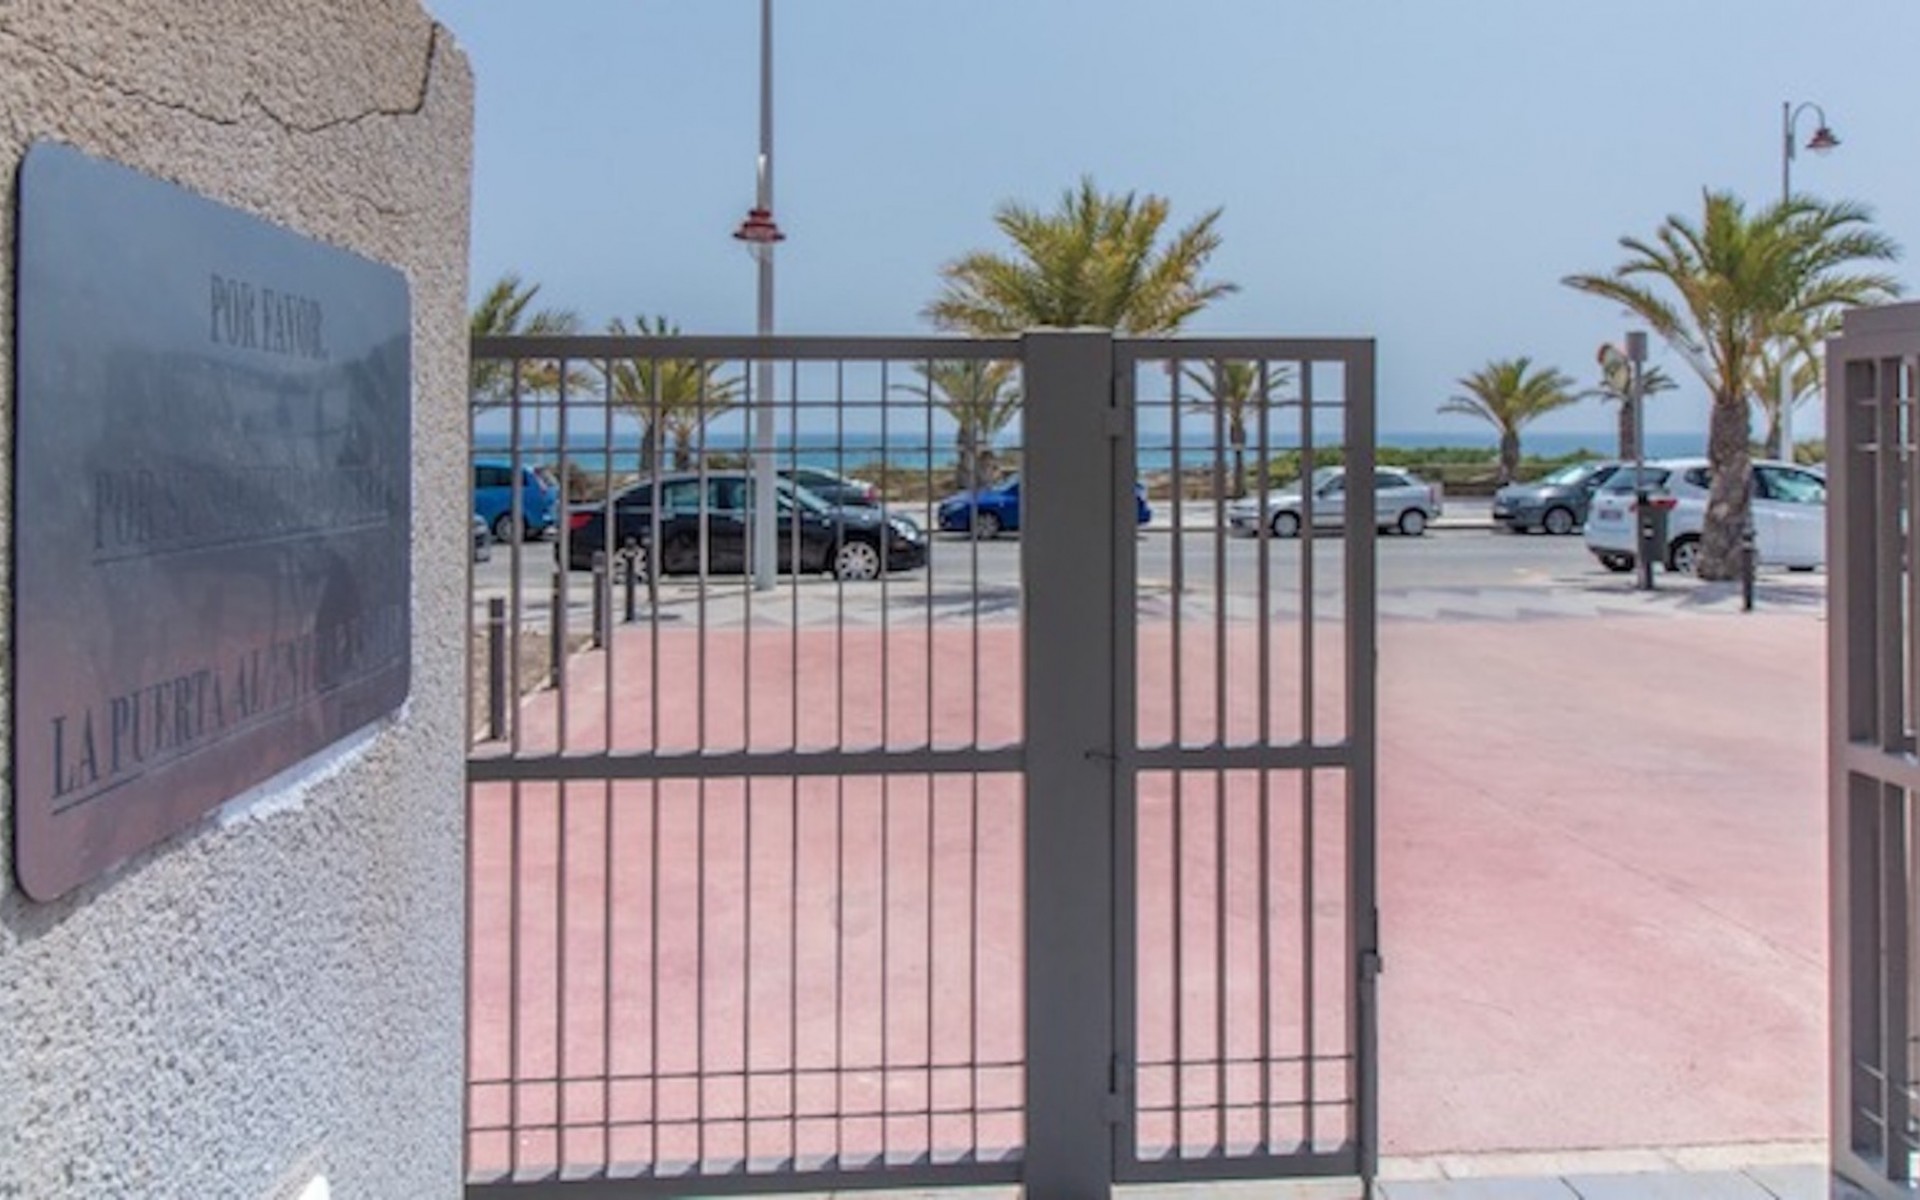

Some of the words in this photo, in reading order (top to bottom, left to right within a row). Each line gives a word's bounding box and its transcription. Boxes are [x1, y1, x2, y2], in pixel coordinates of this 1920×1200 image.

[211, 273, 257, 349] POR
[52, 708, 99, 799] LA
[109, 667, 226, 773] PUERTA
